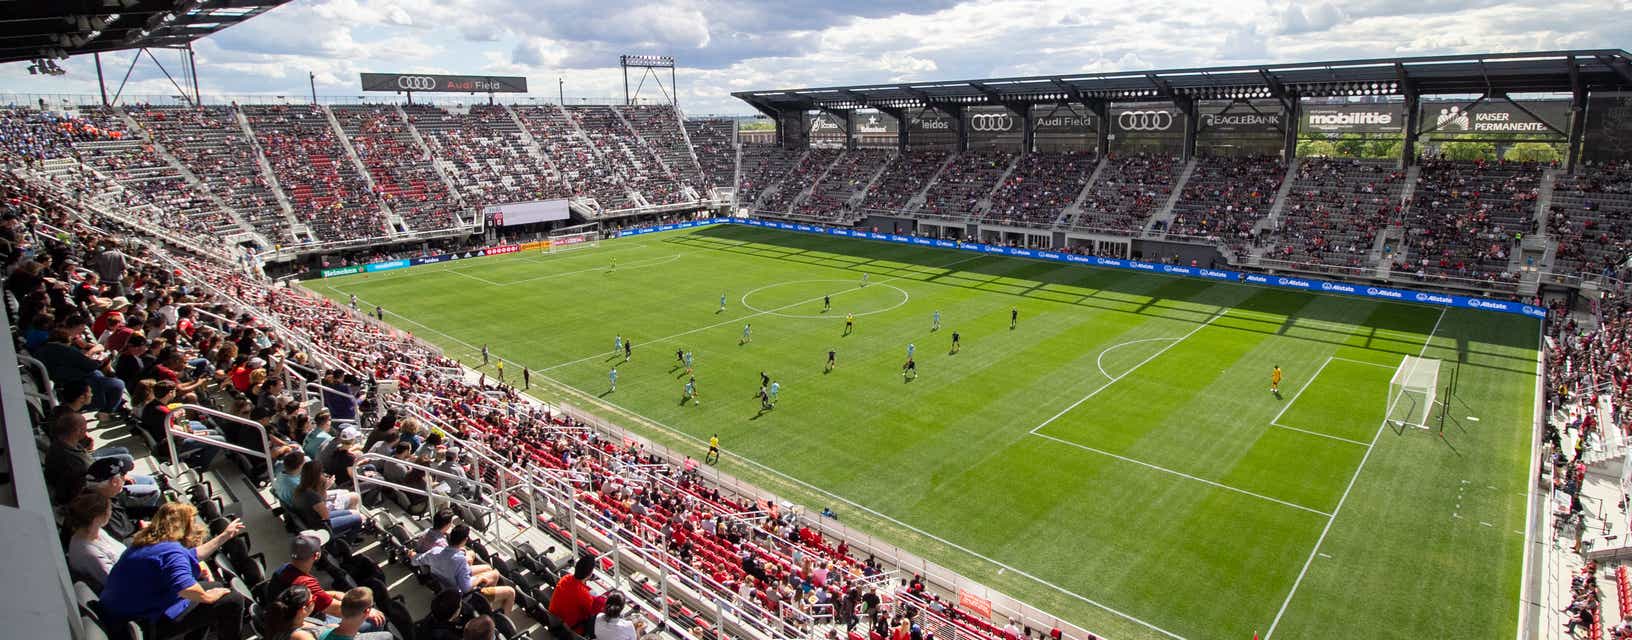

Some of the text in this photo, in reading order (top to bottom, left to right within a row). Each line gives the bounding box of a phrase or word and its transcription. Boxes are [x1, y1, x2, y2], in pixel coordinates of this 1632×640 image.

[447, 81, 500, 90] Audi Field
[1309, 112, 1392, 124] mobilitie
[1475, 112, 1509, 121] KAISER
[921, 119, 949, 129] leidos
[1036, 118, 1091, 127] Audi Field
[1474, 122, 1543, 131] PERMANENTE
[1287, 279, 1309, 287] Allstate
[1332, 284, 1354, 293] Allstate
[1427, 295, 1452, 304] Allstate
[1480, 302, 1507, 310] Allstate
